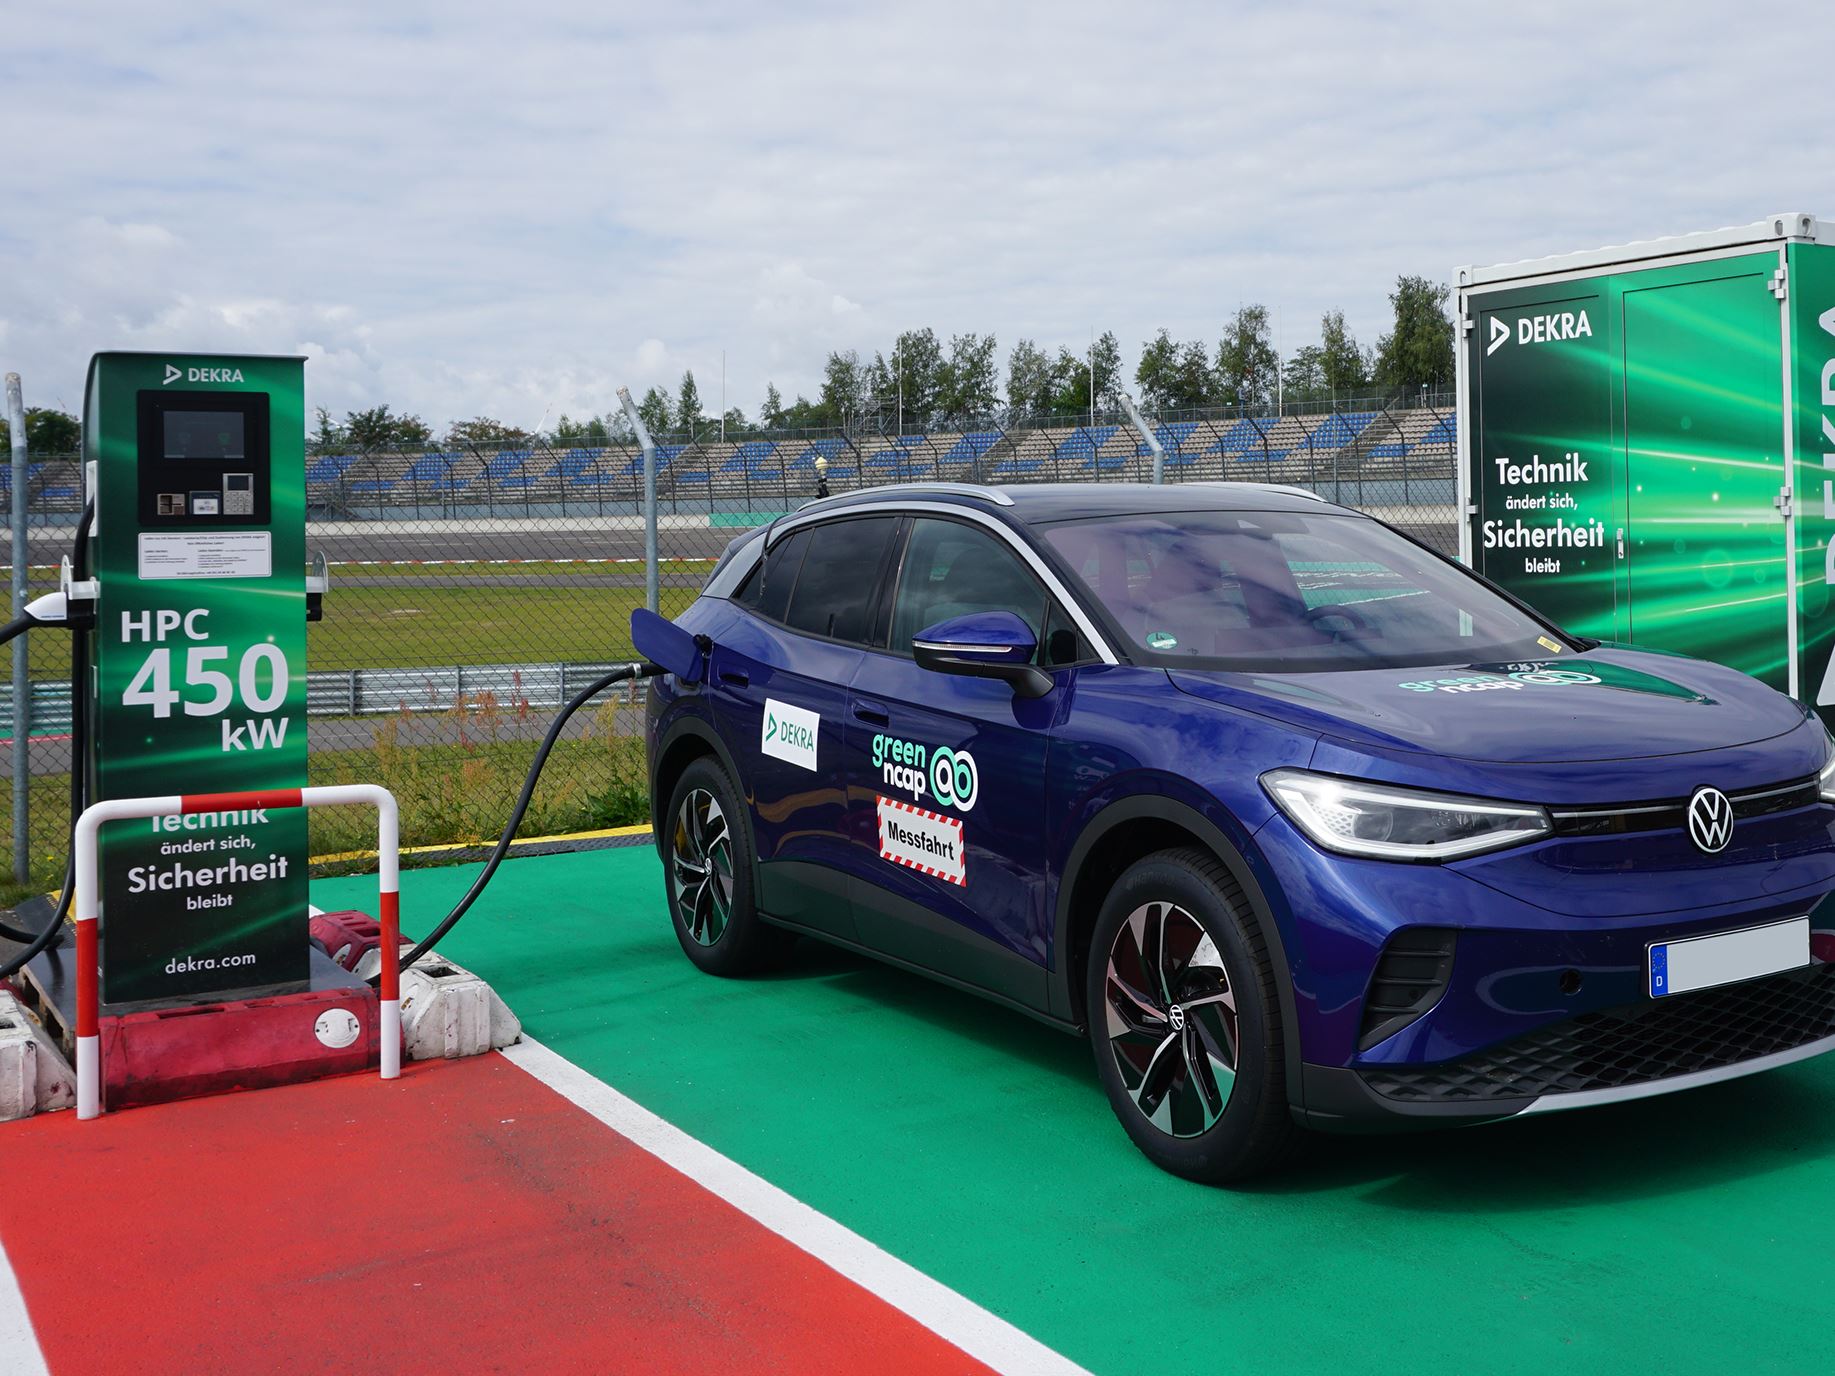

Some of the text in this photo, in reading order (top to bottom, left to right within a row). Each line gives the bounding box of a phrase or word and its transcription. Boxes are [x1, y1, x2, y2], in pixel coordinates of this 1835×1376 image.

[1518, 310, 1593, 345] DEKRA
[188, 367, 245, 383] DEKRA
[1495, 452, 1589, 485] Technik
[1505, 492, 1578, 511] ändert sich,
[1483, 517, 1605, 548] Sicherheit
[1525, 557, 1561, 573] bleibt
[121, 608, 210, 643] HPC
[122, 643, 289, 719] 450
[1398, 673, 1498, 692] green
[1438, 680, 1525, 694] ncap
[221, 717, 289, 752] kW
[780, 721, 815, 752] DEKRA
[872, 733, 926, 768] green
[883, 761, 927, 801] ncap
[160, 834, 256, 855] ändert sich,
[887, 820, 955, 861] Messfahrt
[127, 853, 289, 894] Sicherheit
[186, 893, 233, 911] bleibt
[165, 953, 256, 975] dekra.com
[1656, 975, 1663, 986] D
